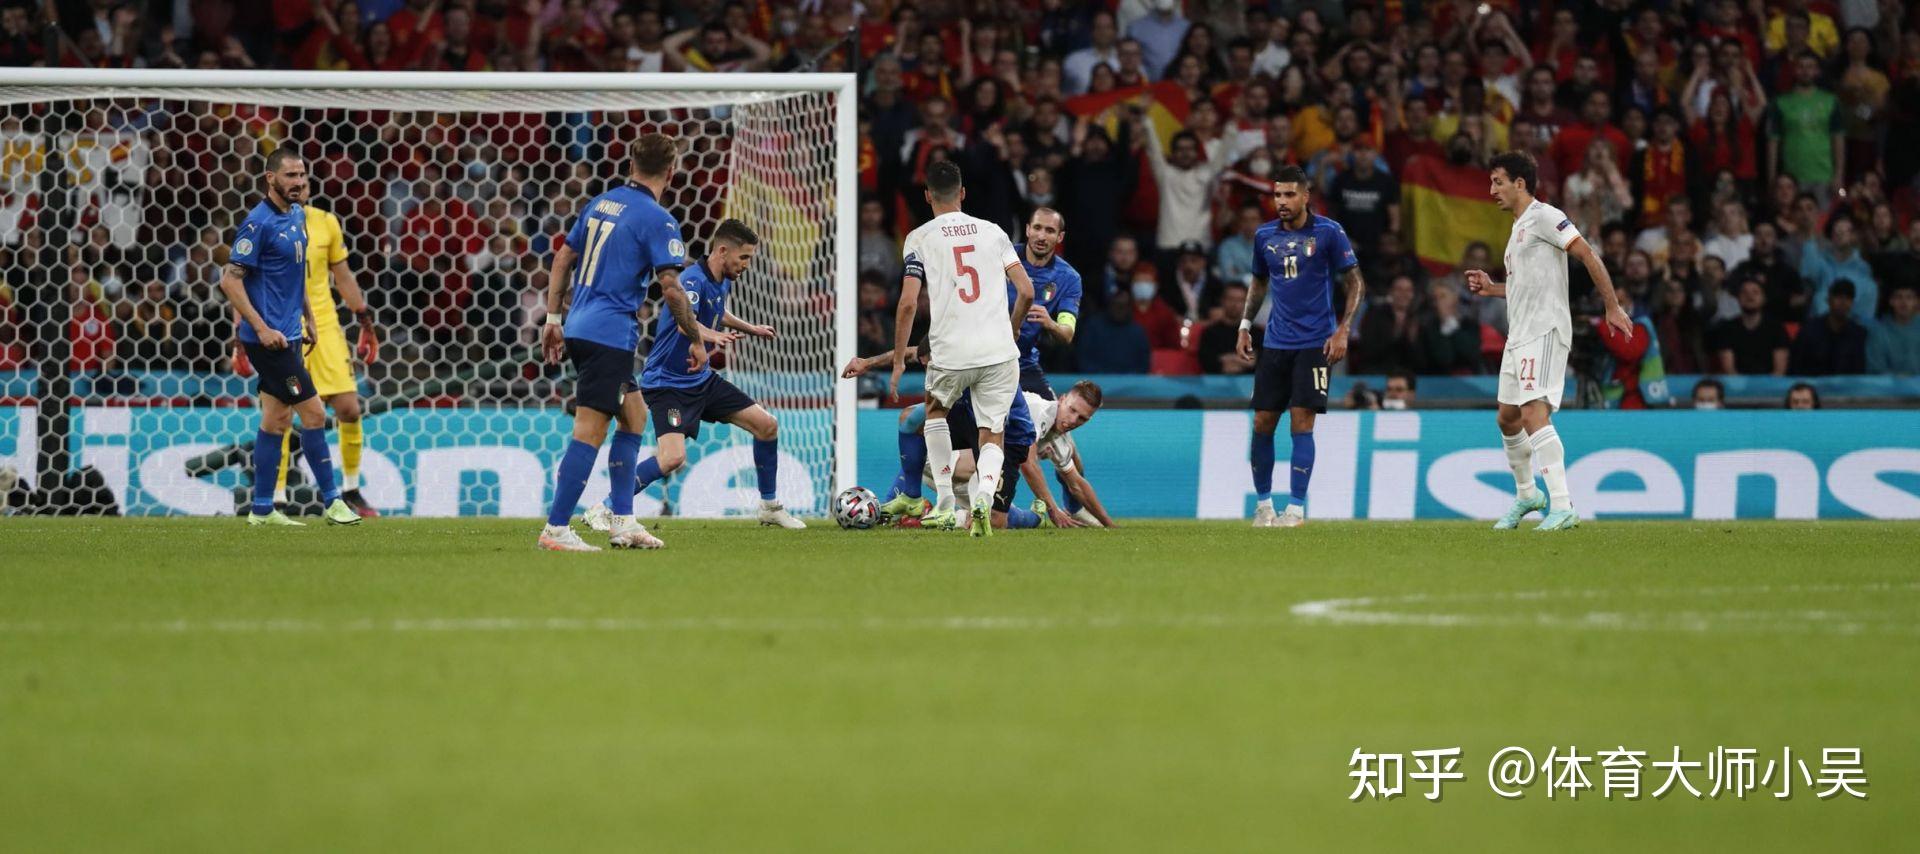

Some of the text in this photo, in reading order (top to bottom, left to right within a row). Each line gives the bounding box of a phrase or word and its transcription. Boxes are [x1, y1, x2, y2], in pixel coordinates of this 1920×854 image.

[941, 223, 978, 238] SERGIO
[578, 217, 616, 287] 17
[952, 244, 980, 304] 5
[1284, 255, 1298, 279] 13
[1311, 366, 1329, 390] 13
[1520, 358, 1535, 381] 21
[0, 405, 816, 517] isense
